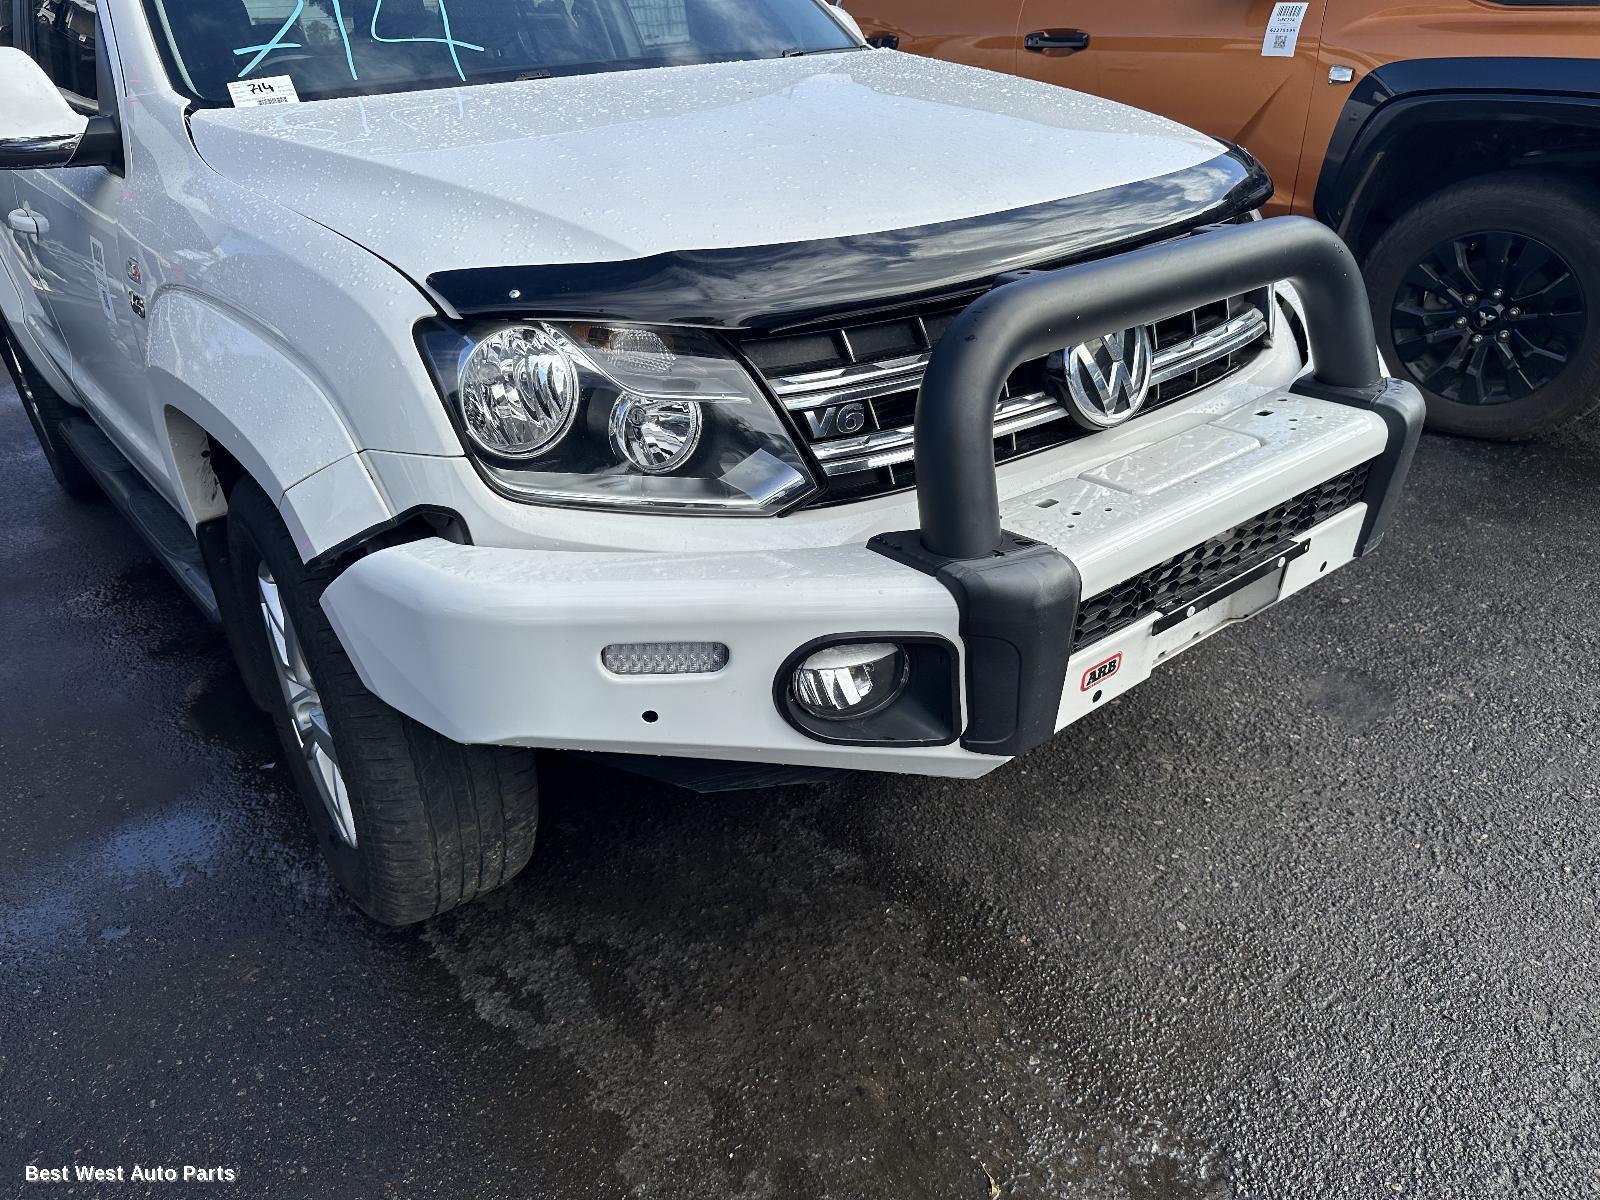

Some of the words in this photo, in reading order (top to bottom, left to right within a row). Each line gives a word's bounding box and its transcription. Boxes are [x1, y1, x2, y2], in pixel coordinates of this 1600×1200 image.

[249, 82, 275, 95] 714
[803, 402, 866, 439] V6
[1086, 659, 1117, 686] ARB
